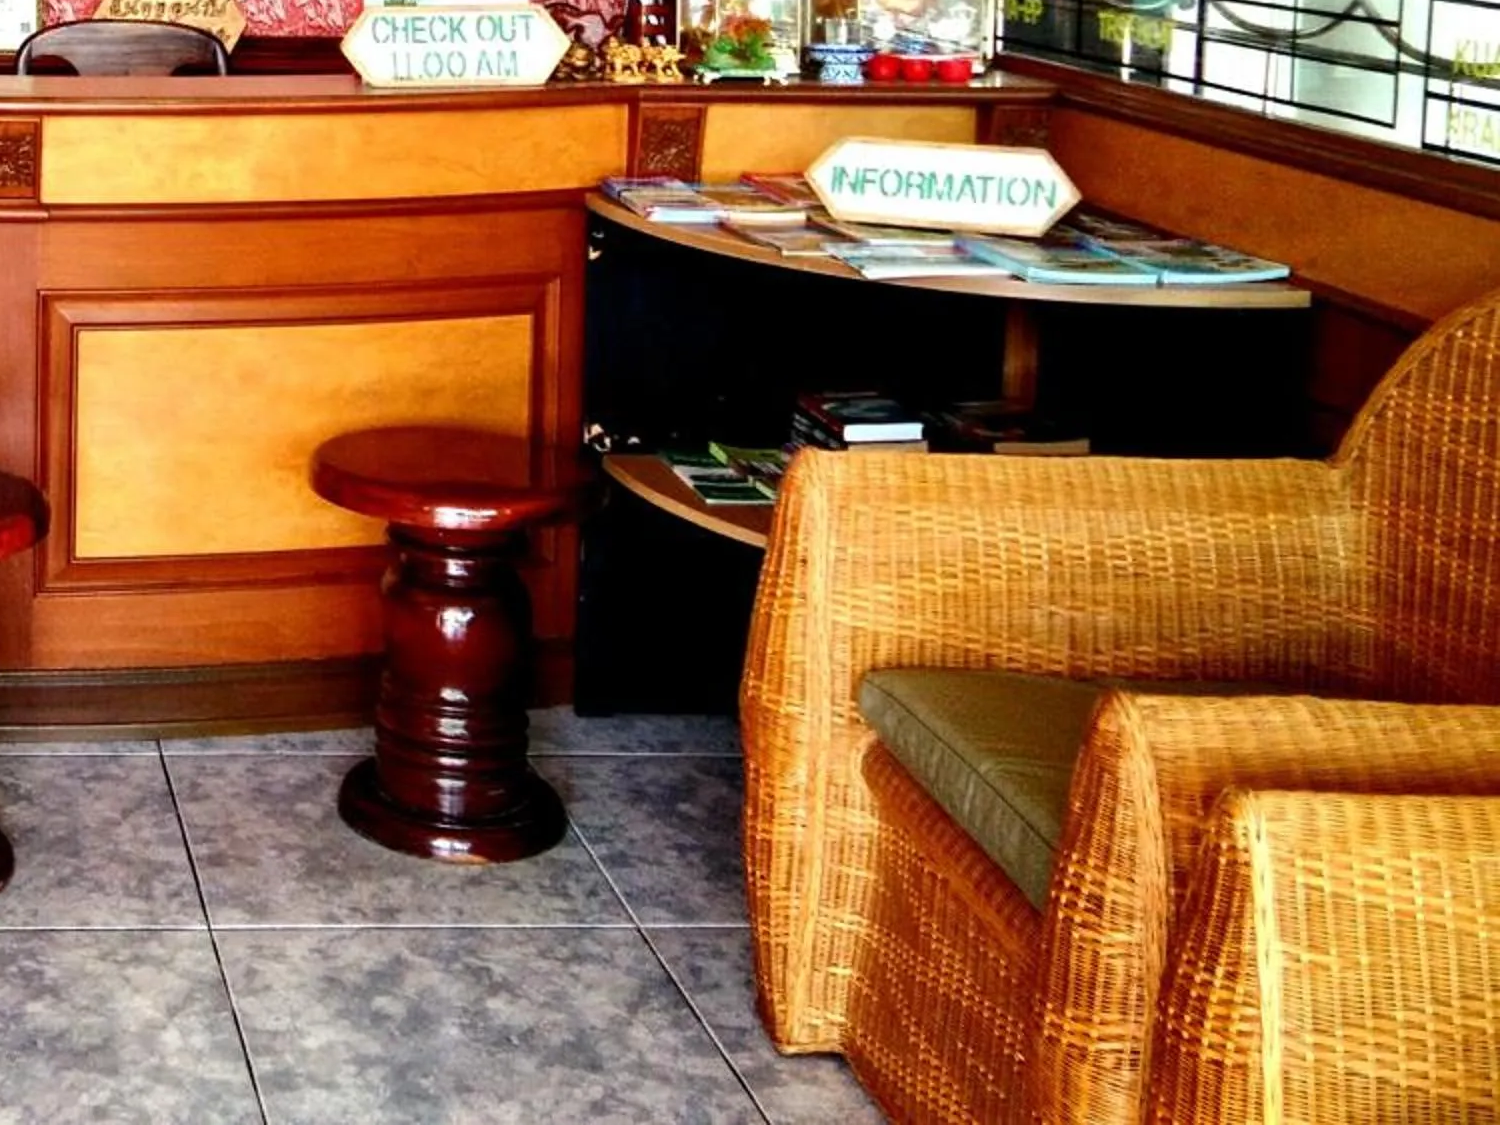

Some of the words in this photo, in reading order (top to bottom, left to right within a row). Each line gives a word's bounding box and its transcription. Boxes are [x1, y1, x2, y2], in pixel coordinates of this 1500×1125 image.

[372, 15, 468, 44] CHECK
[476, 14, 533, 42] OUT
[477, 49, 518, 78] AM
[831, 166, 1057, 209] INFORMATION
